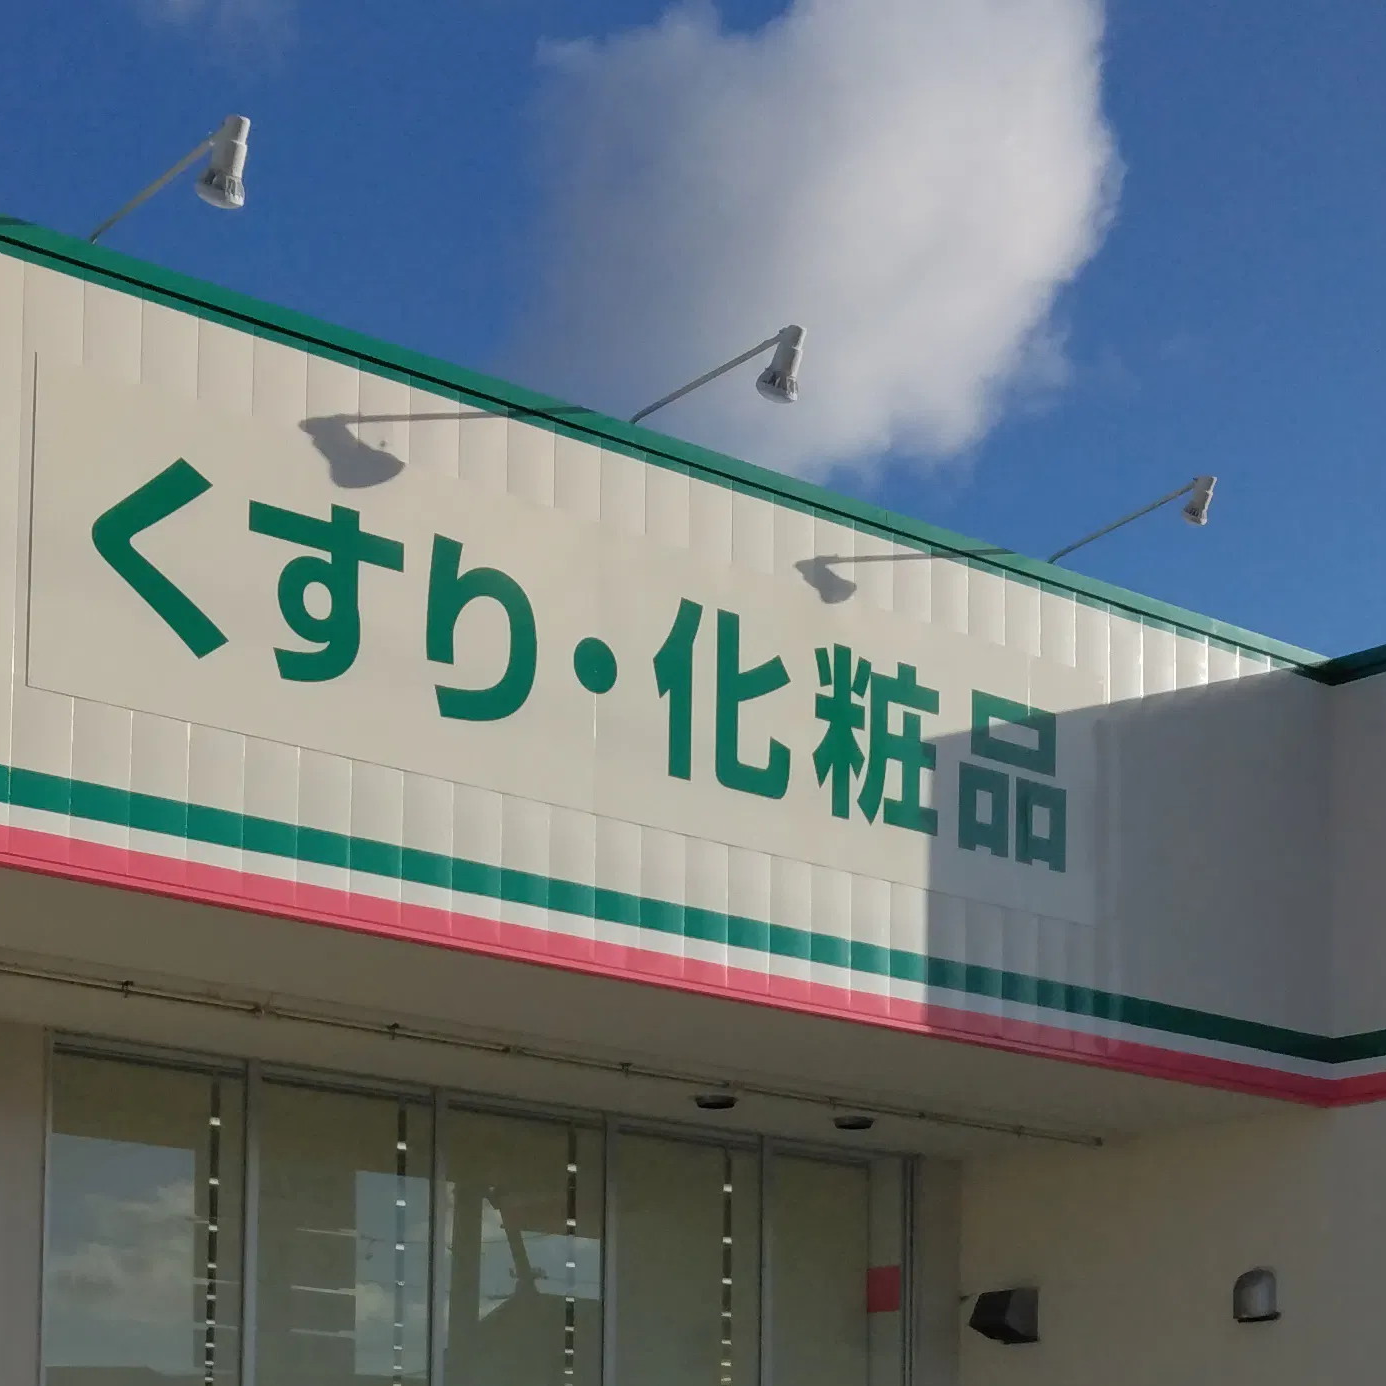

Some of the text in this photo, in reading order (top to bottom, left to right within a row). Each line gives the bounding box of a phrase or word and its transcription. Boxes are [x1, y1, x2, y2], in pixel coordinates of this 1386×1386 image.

[91, 457, 1068, 873] くすり・化粧品
